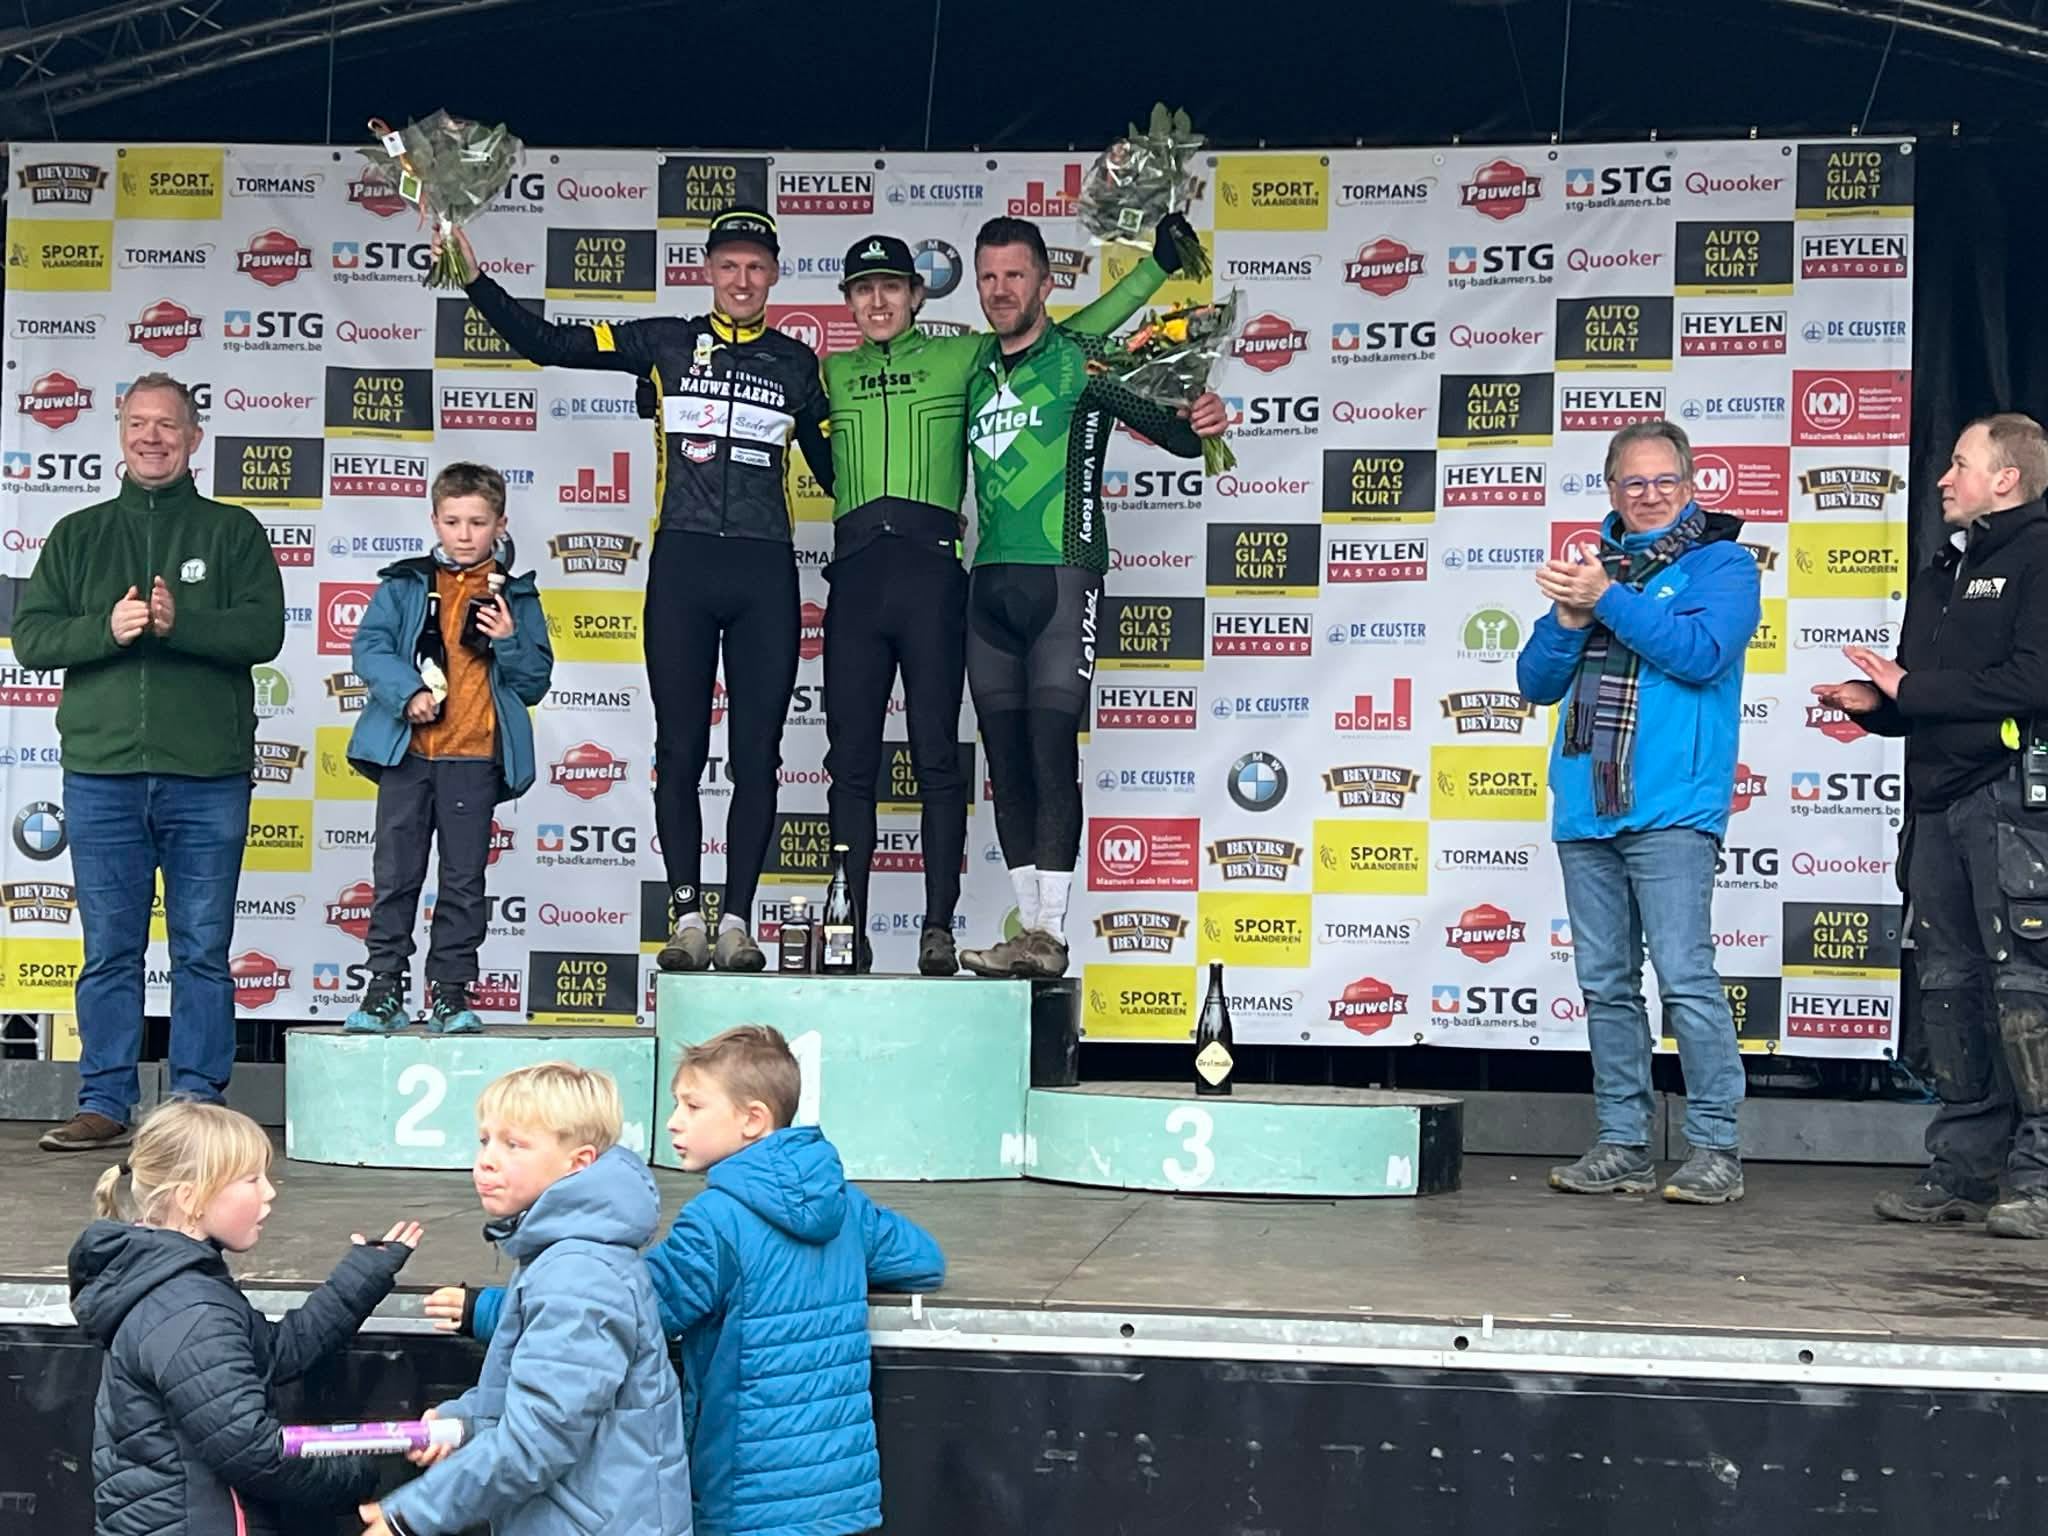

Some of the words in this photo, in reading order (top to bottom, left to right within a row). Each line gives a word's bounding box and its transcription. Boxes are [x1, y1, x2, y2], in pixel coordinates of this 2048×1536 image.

[1827, 152, 1881, 166] AUTO
[150, 173, 214, 188] SPORT.
[1601, 165, 1672, 195] STG
[1827, 169, 1881, 183] GLAS
[237, 177, 315, 194] TORMANS
[558, 178, 647, 201] Quooker
[780, 175, 872, 194] HEYLEN
[1252, 182, 1319, 197] SPORT.
[1343, 184, 1427, 199] TORMANS
[1466, 182, 1535, 200] Pauwels
[1686, 173, 1780, 195] Quooker
[911, 185, 929, 199] DE
[934, 185, 983, 199] CEUSTER
[1826, 185, 1881, 200] KURT
[780, 201, 871, 211] VASTGOED
[1565, 196, 1672, 211] stg-badkamers.be
[576, 238, 626, 252] AUTO
[1705, 231, 1759, 245] AUTO
[42, 245, 104, 259] SPORT.
[1705, 248, 1759, 261] GLAS
[1805, 238, 1905, 258] HEYLEN
[126, 248, 206, 264] TORMANS
[242, 252, 309, 268] Pauwels
[575, 254, 625, 268] GLAS
[1483, 245, 1554, 272] STG
[1567, 247, 1661, 272] Quooker
[1227, 260, 1312, 276] TORMANS
[1350, 259, 1420, 278] Pauwels
[1705, 263, 1759, 278] KURT
[1806, 264, 1904, 273] VASTGOED
[574, 269, 625, 283] KURT
[1448, 274, 1553, 288] stg-badkamers.be
[1585, 306, 1640, 320] AUTO
[18, 319, 96, 335] TORMANS
[134, 320, 199, 337] Pauwels
[257, 312, 323, 339] STG
[336, 320, 421, 344] Quooker
[1585, 322, 1639, 336] GLAS
[1685, 315, 1782, 334] HEYLEN
[1828, 323, 1843, 336] DE
[1849, 321, 1906, 336] CEUSTER
[1234, 333, 1303, 354] Pauwels
[1366, 323, 1436, 349] STG
[1451, 325, 1543, 347] Quooker
[223, 341, 322, 352] stg-badkamers.be
[1585, 338, 1639, 352] KURT
[1685, 341, 1783, 350] VASTGOED
[1331, 351, 1436, 364] stg-badkamers.be
[354, 377, 404, 392] AUTO
[24, 388, 91, 410] Pauwels
[225, 388, 313, 411] Quooker
[353, 393, 403, 408] GLAS
[444, 390, 535, 409] HEYLEN
[1706, 398, 1723, 413] DE
[1727, 397, 1785, 413] CEUSTER
[353, 408, 404, 423] KURT
[1333, 401, 1427, 424] Quooker
[444, 416, 535, 426] VASTGOED
[968, 406, 1042, 444] eVHeL
[1084, 410, 1100, 450] Wim
[243, 446, 292, 459] AUTO
[38, 454, 100, 480] STG
[242, 462, 291, 475] GLAS
[333, 457, 425, 477] HEYLEN
[1352, 459, 1404, 473] AUTO
[1083, 458, 1096, 492] Van
[1352, 475, 1403, 489] GLAS
[1448, 467, 1542, 485] HEYLEN
[1820, 468, 1881, 484] BEVERS
[2, 483, 100, 494] stg-badkamers.be
[242, 477, 291, 491] KURT
[334, 481, 424, 493] VASTGOED
[1135, 471, 1202, 496] STG
[1216, 476, 1310, 498] Quooker
[563, 489, 627, 499] OOMS
[1352, 491, 1403, 505] KURT
[1448, 492, 1542, 501] VASTGOED
[1820, 492, 1881, 508] BEVERS
[353, 537, 368, 551] DE
[371, 537, 423, 552] CEUSTER
[1331, 543, 1424, 561] HEYLEN
[1468, 549, 1485, 562] DE
[1489, 549, 1544, 562] CEUSTER
[1828, 550, 1899, 564] SPORT.
[1331, 567, 1424, 577] VASTGOED
[1827, 566, 1898, 574] VLAANDEREN
[1120, 606, 1172, 620] AUTO
[574, 616, 637, 630] SPORT.
[1120, 621, 1171, 635] GLAS
[1216, 616, 1309, 634] HEYLEN
[574, 631, 636, 640] VLAANDEREN
[1351, 624, 1367, 637] DE
[1371, 624, 1426, 638] CEUSTER
[1802, 629, 1890, 643] TORMANS
[1120, 637, 1172, 652] KURT
[1216, 641, 1309, 653] VASTGOED
[551, 691, 630, 707] TORMANS
[1101, 689, 1193, 707] HEYLEN
[1237, 699, 1253, 712] DE
[1256, 697, 1309, 711] CEUSTER
[1461, 693, 1520, 709] BEVERS
[1101, 715, 1192, 724] VASTGOED
[1340, 715, 1407, 728] OOMS
[1461, 717, 1520, 733] BEVERS
[555, 765, 622, 780] Pauwels
[1121, 772, 1137, 785] DE
[1142, 771, 1195, 785] CEUSTER
[1343, 768, 1402, 783] BEVERS
[1469, 773, 1537, 787] SPORT.
[1469, 788, 1537, 796] VLAANDEREN
[1827, 774, 1901, 801] STG
[1343, 792, 1402, 807] BEVERS
[1791, 805, 1900, 816] stg-badkamers.be
[570, 827, 636, 853] STG
[1226, 840, 1285, 856] BEVERS
[1351, 847, 1419, 861] SPORT.
[536, 856, 635, 866] stg-badkamers.be
[1443, 850, 1529, 865] TORMANS
[1792, 853, 1890, 875] Quooker
[1226, 864, 1285, 879] BEVERS
[1351, 862, 1418, 871] VLAANDEREN
[539, 903, 628, 925] Quooker
[1112, 913, 1170, 929] BEVERS
[1814, 912, 1869, 926] AUTO
[1235, 920, 1302, 933] SPORT.
[1325, 923, 1410, 939] TORMANS
[1235, 935, 1301, 943] VLAANDEREN
[1452, 927, 1521, 943] Pauwels
[1814, 929, 1868, 943] GLAS
[1113, 937, 1169, 952] BEVERS
[1814, 945, 1868, 959] KURT
[557, 961, 607, 975] AUTO
[557, 978, 606, 991] GLAS
[557, 992, 606, 1006] KURT
[1120, 992, 1187, 1005] SPORT.
[1466, 987, 1537, 1014] STG
[1791, 997, 1889, 1015] HEYLEN
[1120, 1007, 1186, 1015] VLAANDEREN
[1334, 999, 1403, 1016] Pauwels
[1431, 1017, 1537, 1028] stg-badkamers.be
[1791, 1022, 1888, 1035] VASTGOED
[789, 1030, 821, 1127] 1
[395, 1064, 447, 1146] 2
[1162, 1107, 1215, 1188] 3
